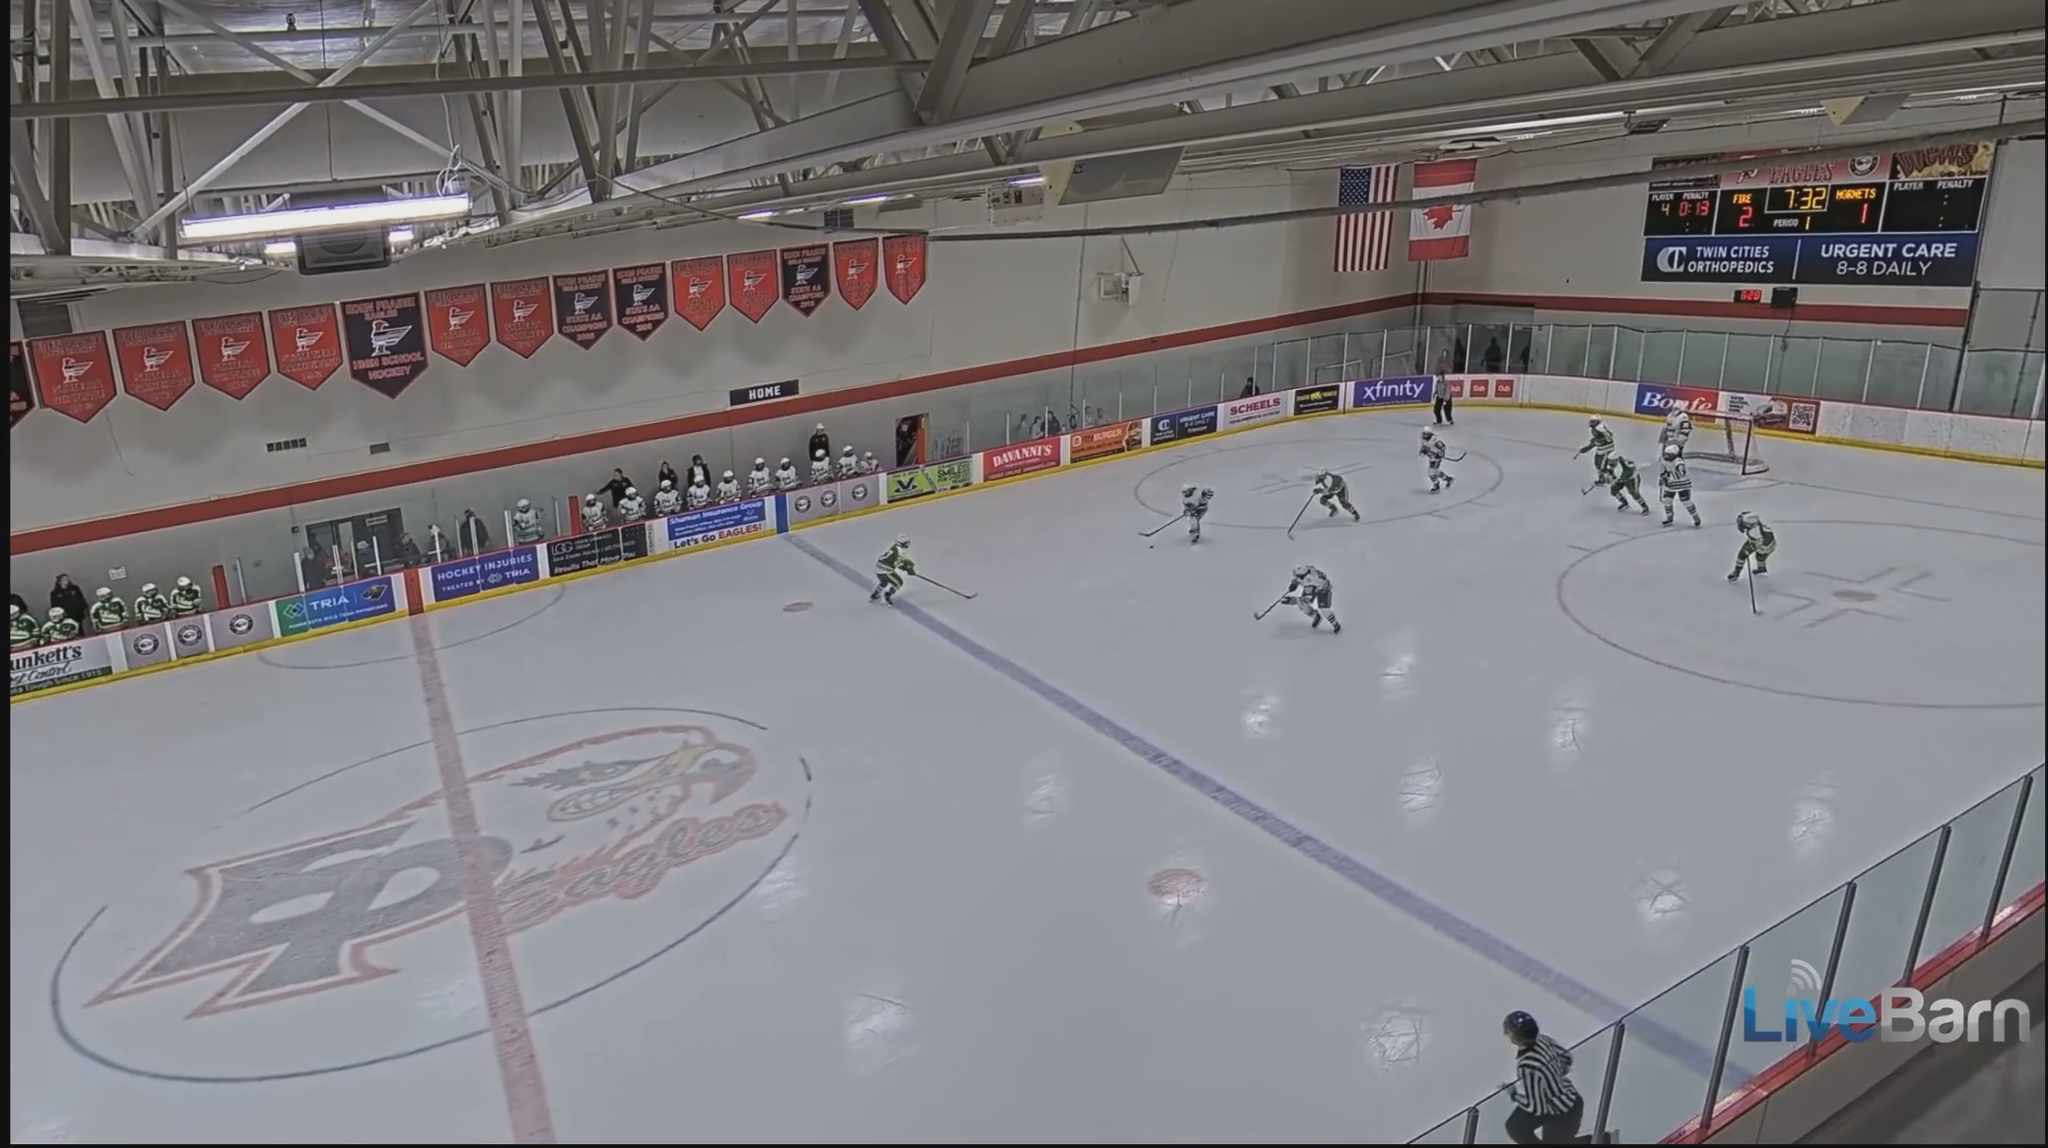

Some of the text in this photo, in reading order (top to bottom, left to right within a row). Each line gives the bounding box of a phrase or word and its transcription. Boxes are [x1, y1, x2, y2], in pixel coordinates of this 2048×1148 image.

[1770, 161, 1835, 184] EAGLES
[1836, 188, 1876, 200] HORNETS
[1893, 179, 1973, 191] PLAYER PENALTY
[1785, 188, 1827, 209] 7:32
[1661, 201, 1710, 216] 4 0:13
[1739, 207, 1752, 228] 2
[1862, 203, 1868, 224] 1
[1805, 216, 1811, 231] 1
[1696, 246, 1769, 258] TWIN CITIES
[1821, 243, 1957, 258] URGENT CARE
[1687, 261, 1774, 273] ORTHOPEDICS
[1836, 261, 1932, 275] 8-8 DAILY
[749, 385, 781, 400] HOME
[1363, 380, 1425, 401] xfinity
[1230, 398, 1281, 416] SCHEELS
[993, 445, 1052, 467] DAVANNI'S
[674, 537, 699, 548] Let's
[702, 534, 716, 543] Go
[719, 523, 762, 539] EAGLES!
[437, 554, 532, 581] HOCKEY INJURIES
[555, 563, 580, 574] Results
[582, 559, 599, 568] That
[601, 554, 620, 563] Move
[442, 581, 474, 592] TREATED
[504, 568, 531, 579] TRIA
[309, 595, 349, 610] TRIA
